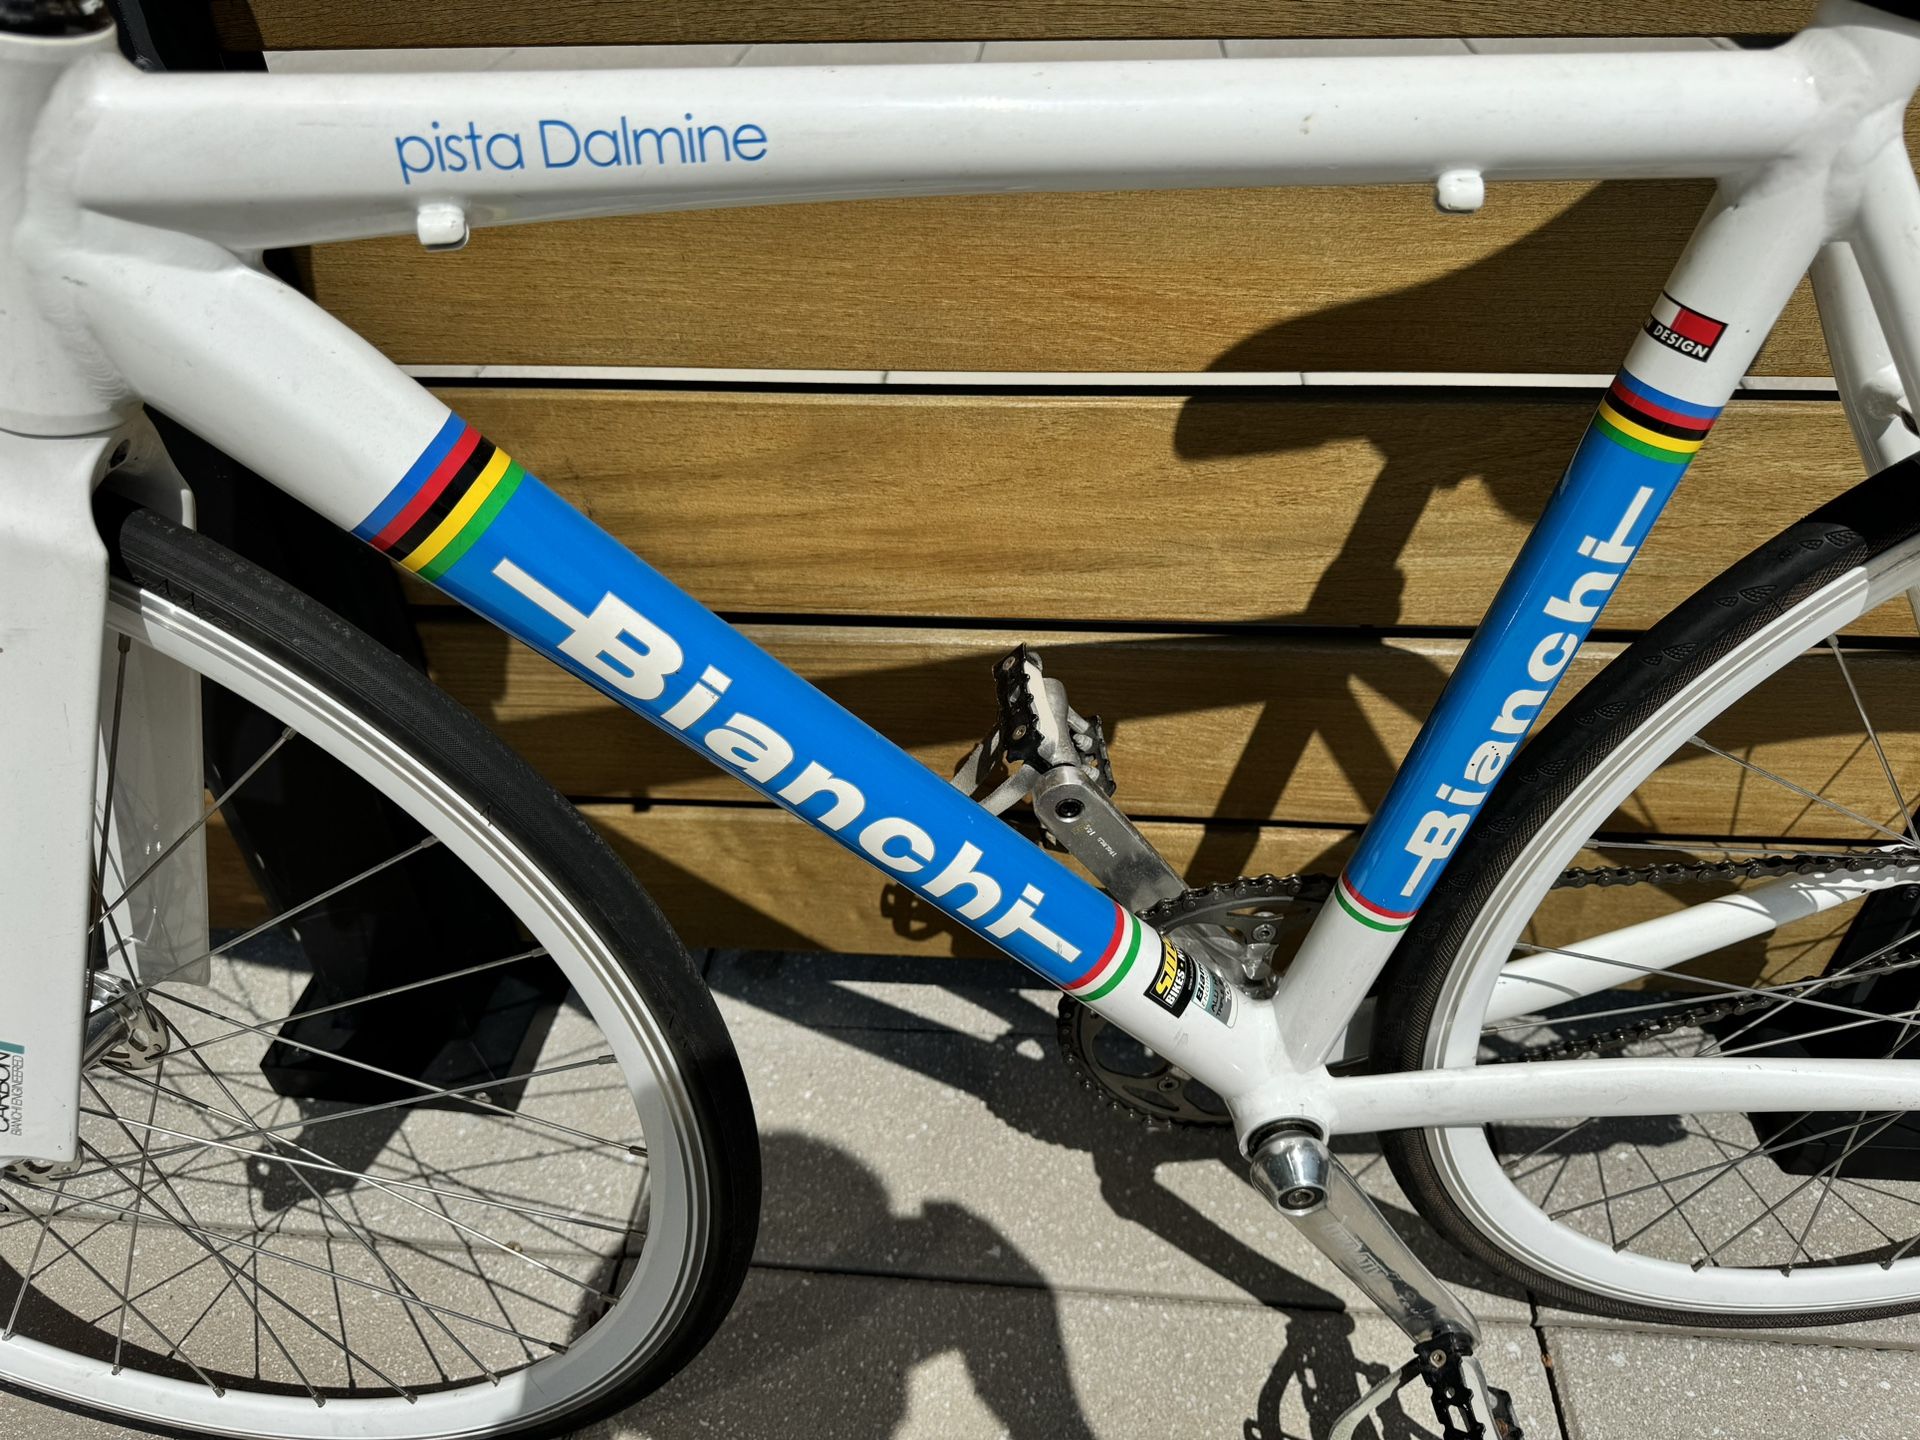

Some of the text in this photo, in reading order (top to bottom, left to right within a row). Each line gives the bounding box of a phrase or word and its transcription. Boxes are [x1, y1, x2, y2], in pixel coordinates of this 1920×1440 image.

[395, 112, 768, 185] pista Dalmine
[1653, 324, 1709, 358] DESIGN
[1400, 486, 1654, 896] Bianchi
[492, 557, 1082, 963] Bianchi
[1164, 968, 1185, 1005] BIKES
[11, 1054, 24, 1106] ENGINEERED
